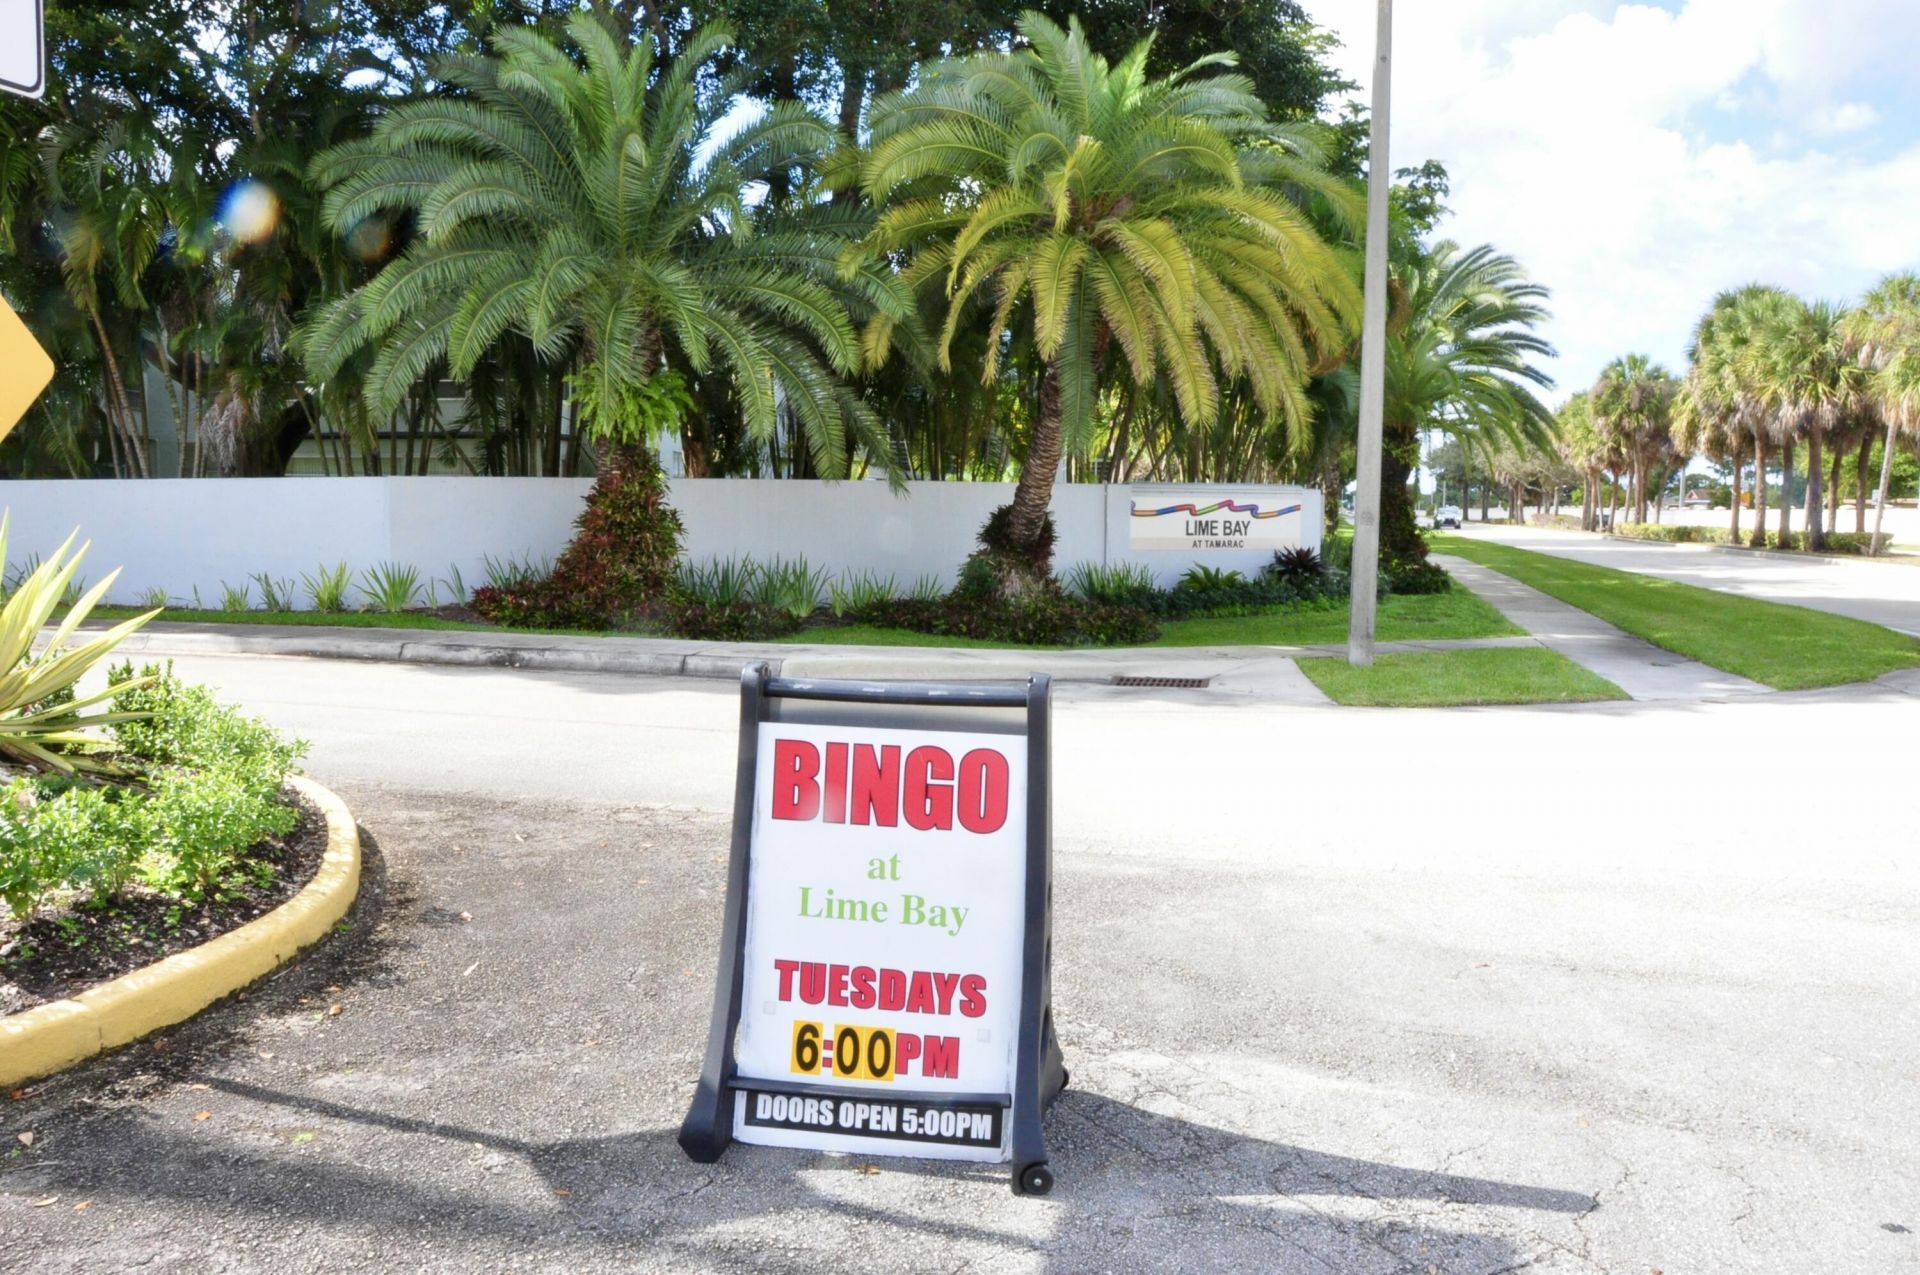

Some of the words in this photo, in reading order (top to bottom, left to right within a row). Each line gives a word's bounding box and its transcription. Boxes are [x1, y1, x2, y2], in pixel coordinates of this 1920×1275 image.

[1185, 520, 1219, 536] LIME
[1223, 520, 1250, 536] BAY
[1192, 540, 1203, 549] AT
[1205, 540, 1244, 549] TAMARAC
[771, 738, 1010, 834] BINGO
[867, 853, 902, 881] at
[797, 886, 888, 923] Lime
[899, 894, 970, 937] Bay
[774, 959, 987, 1018] TUESDAYS
[756, 1094, 834, 1126] DOORS
[838, 1101, 898, 1132] OPEN
[902, 1107, 993, 1140] 5:00PM
